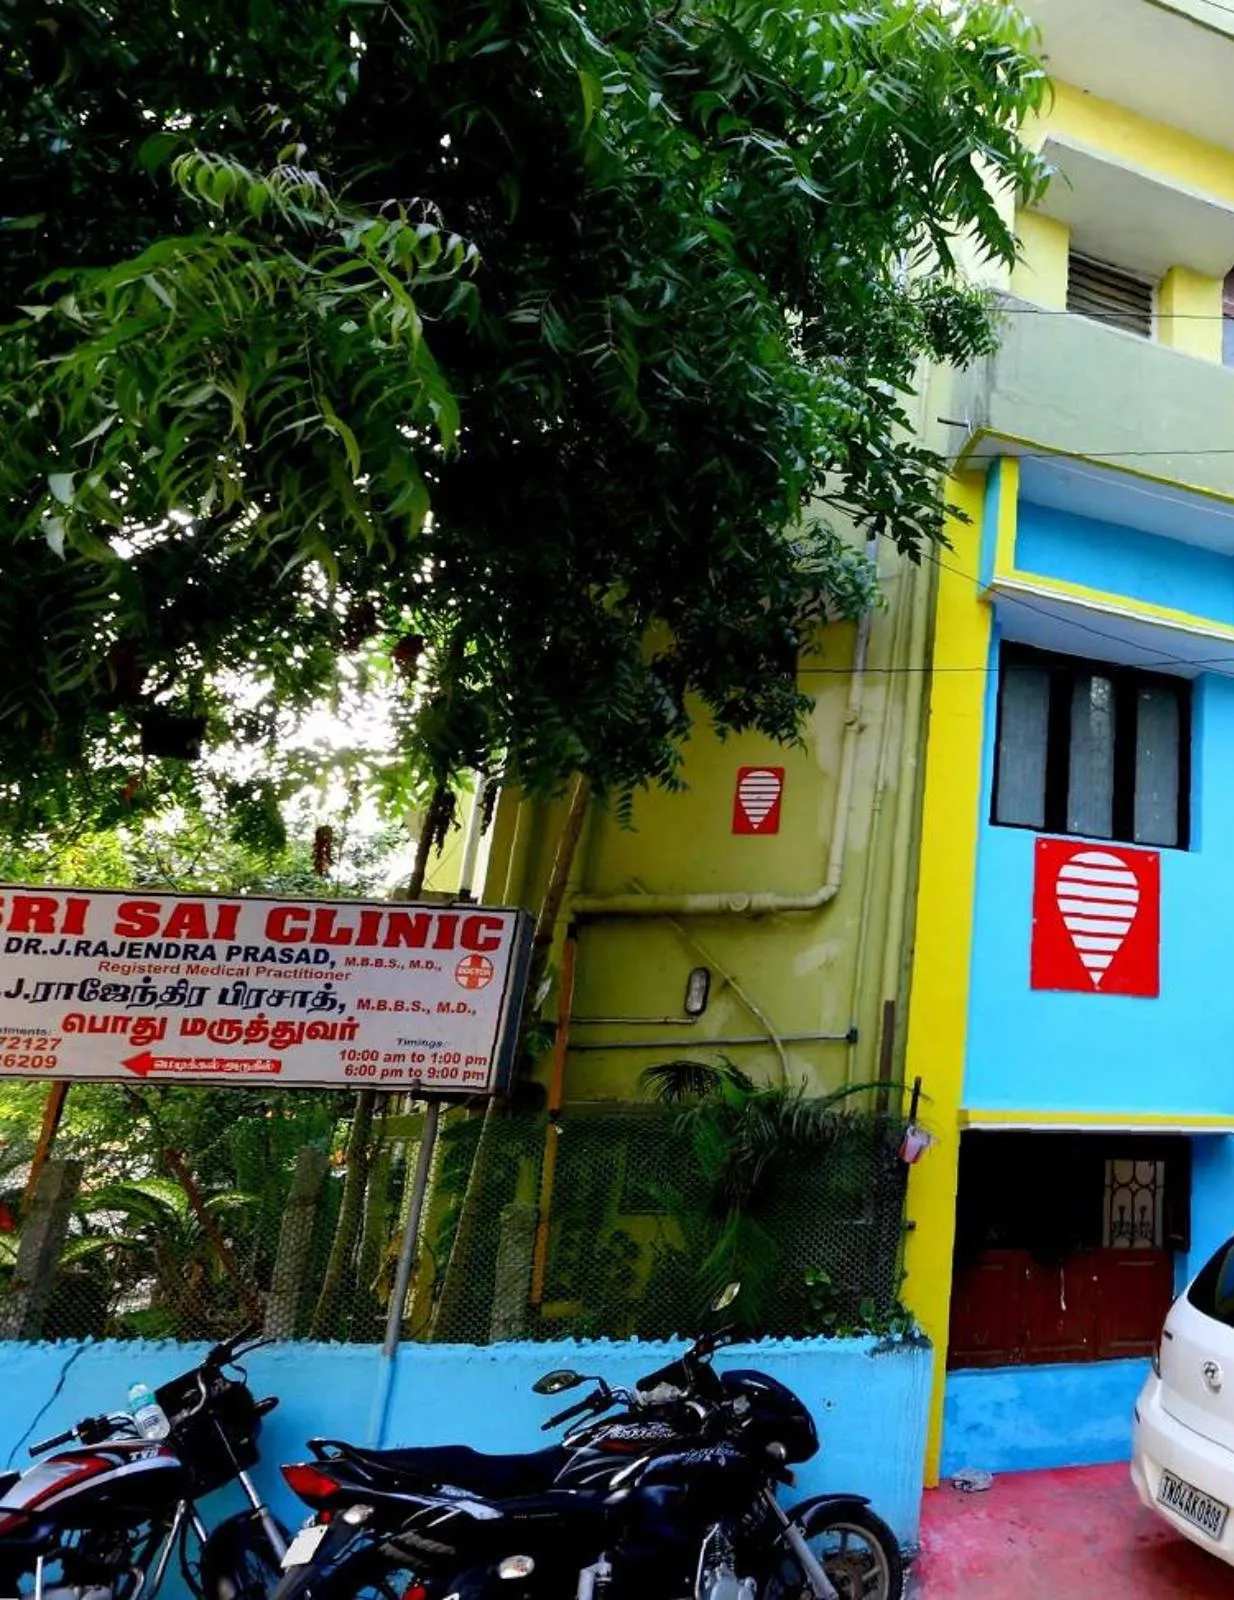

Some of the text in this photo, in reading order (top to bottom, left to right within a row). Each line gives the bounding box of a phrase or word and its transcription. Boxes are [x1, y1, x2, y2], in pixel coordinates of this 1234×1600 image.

[0, 896, 505, 951] RI SAI CLINIC
[4, 937, 217, 962] DR.J.RAJENDRA
[226, 945, 337, 969] PRASAD,
[98, 961, 352, 981] Registerd Medical Practitioner
[0, 976, 211, 1009] J.ராஜேந்திர
[61, 1013, 361, 1050] பொது மருத்துவர்
[0, 1053, 58, 1069] 6209
[339, 1049, 488, 1067] 10:00 am to 1:00 pm
[344, 1063, 485, 1081] 6:00 pm to 9:00 pm
